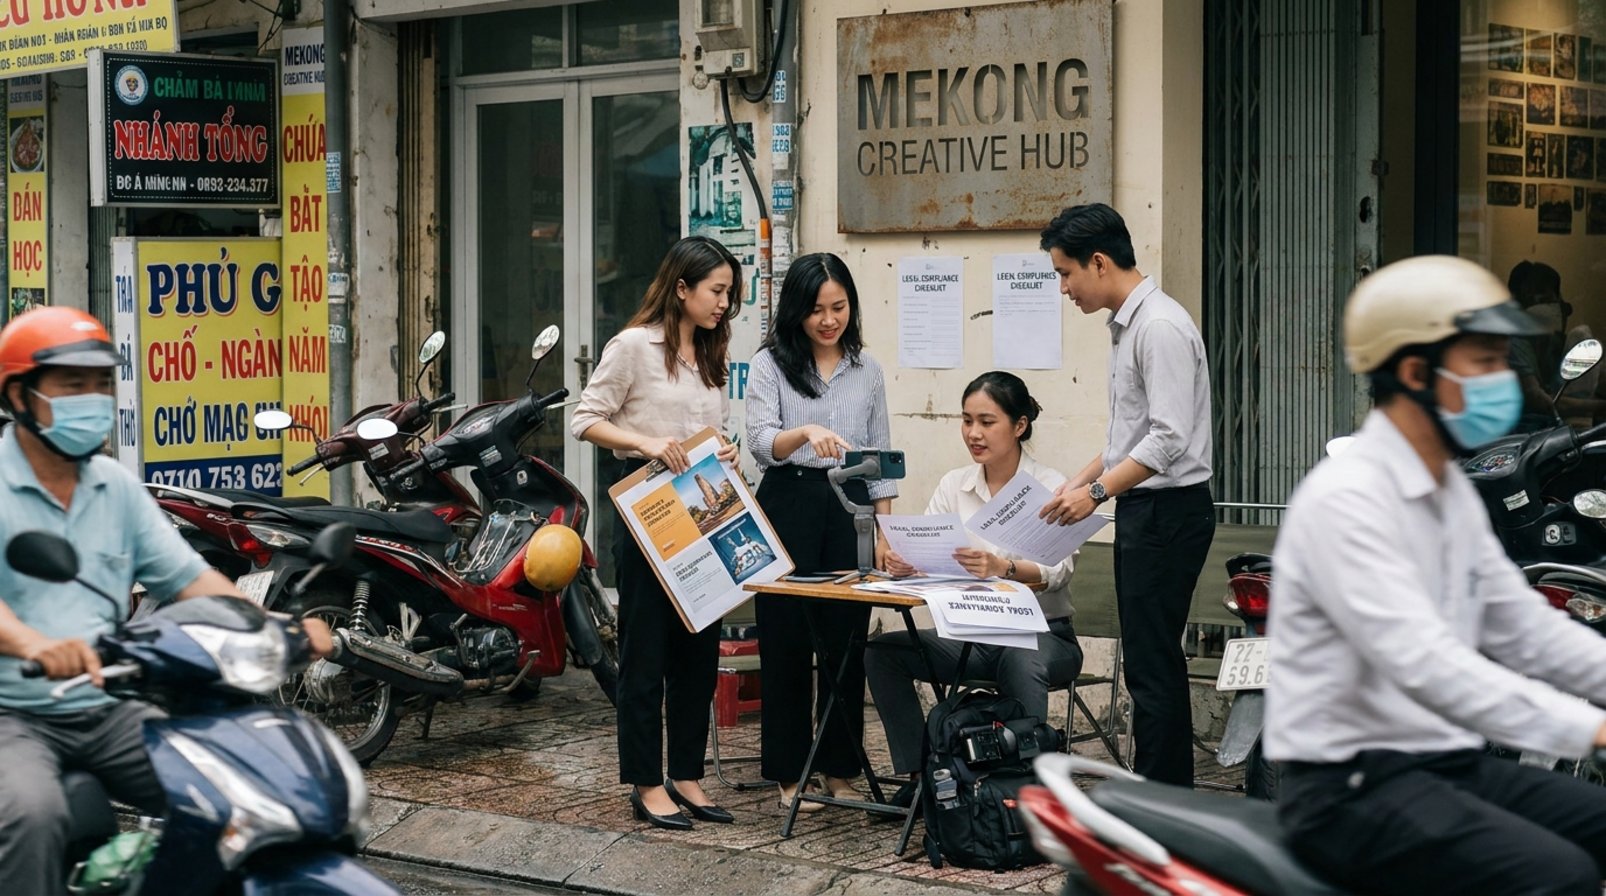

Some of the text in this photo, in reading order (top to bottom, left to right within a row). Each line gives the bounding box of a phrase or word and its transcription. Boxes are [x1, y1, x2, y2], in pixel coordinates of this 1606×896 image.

[857, 58, 1089, 130] MEKONG
[113, 109, 200, 161] NHÁNH
[857, 131, 1090, 177] CREATIVE HUB
[13, 239, 43, 277] HỌC
[147, 325, 197, 383] CHỐ
[288, 326, 326, 373] NĂM
[208, 462, 246, 490] 753
